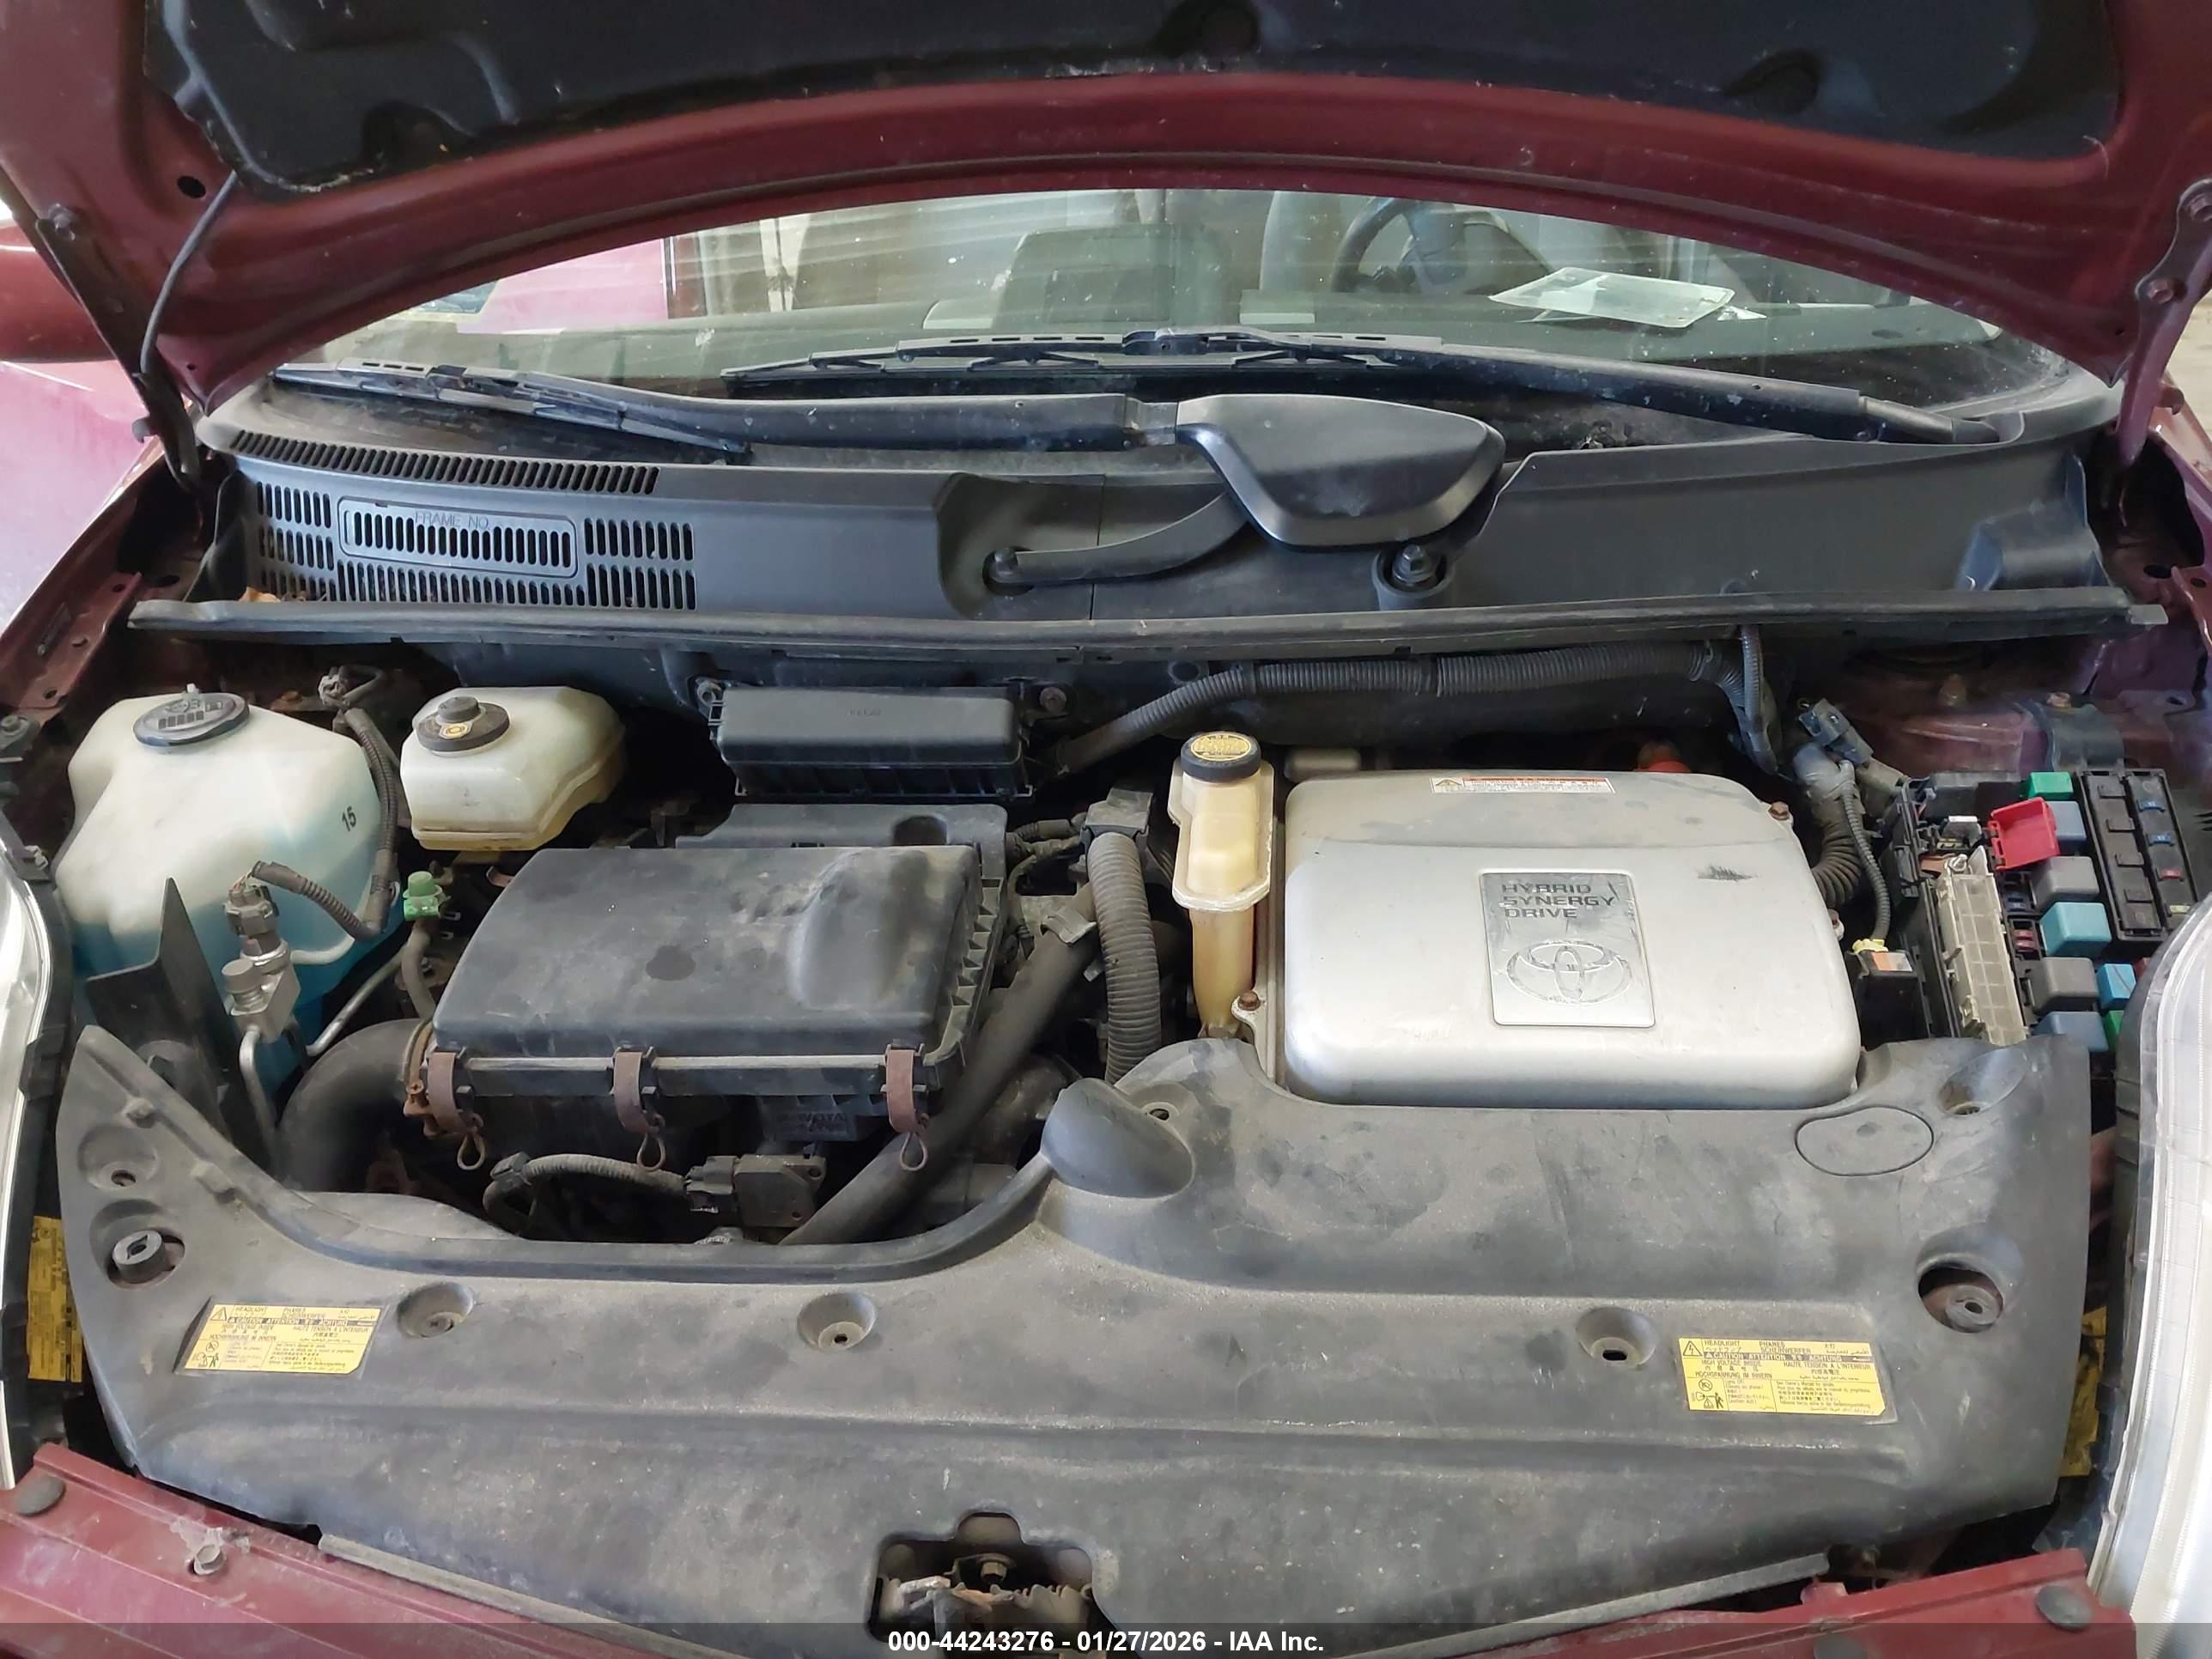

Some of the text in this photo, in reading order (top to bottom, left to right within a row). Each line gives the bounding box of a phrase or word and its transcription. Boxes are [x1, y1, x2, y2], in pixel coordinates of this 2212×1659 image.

[415, 511, 460, 527] FRAME
[342, 805, 356, 832] 15
[1503, 884, 1591, 894] HYBRID
[1504, 896, 1615, 906] SYNERGY
[1505, 908, 1577, 918] DRIVE
